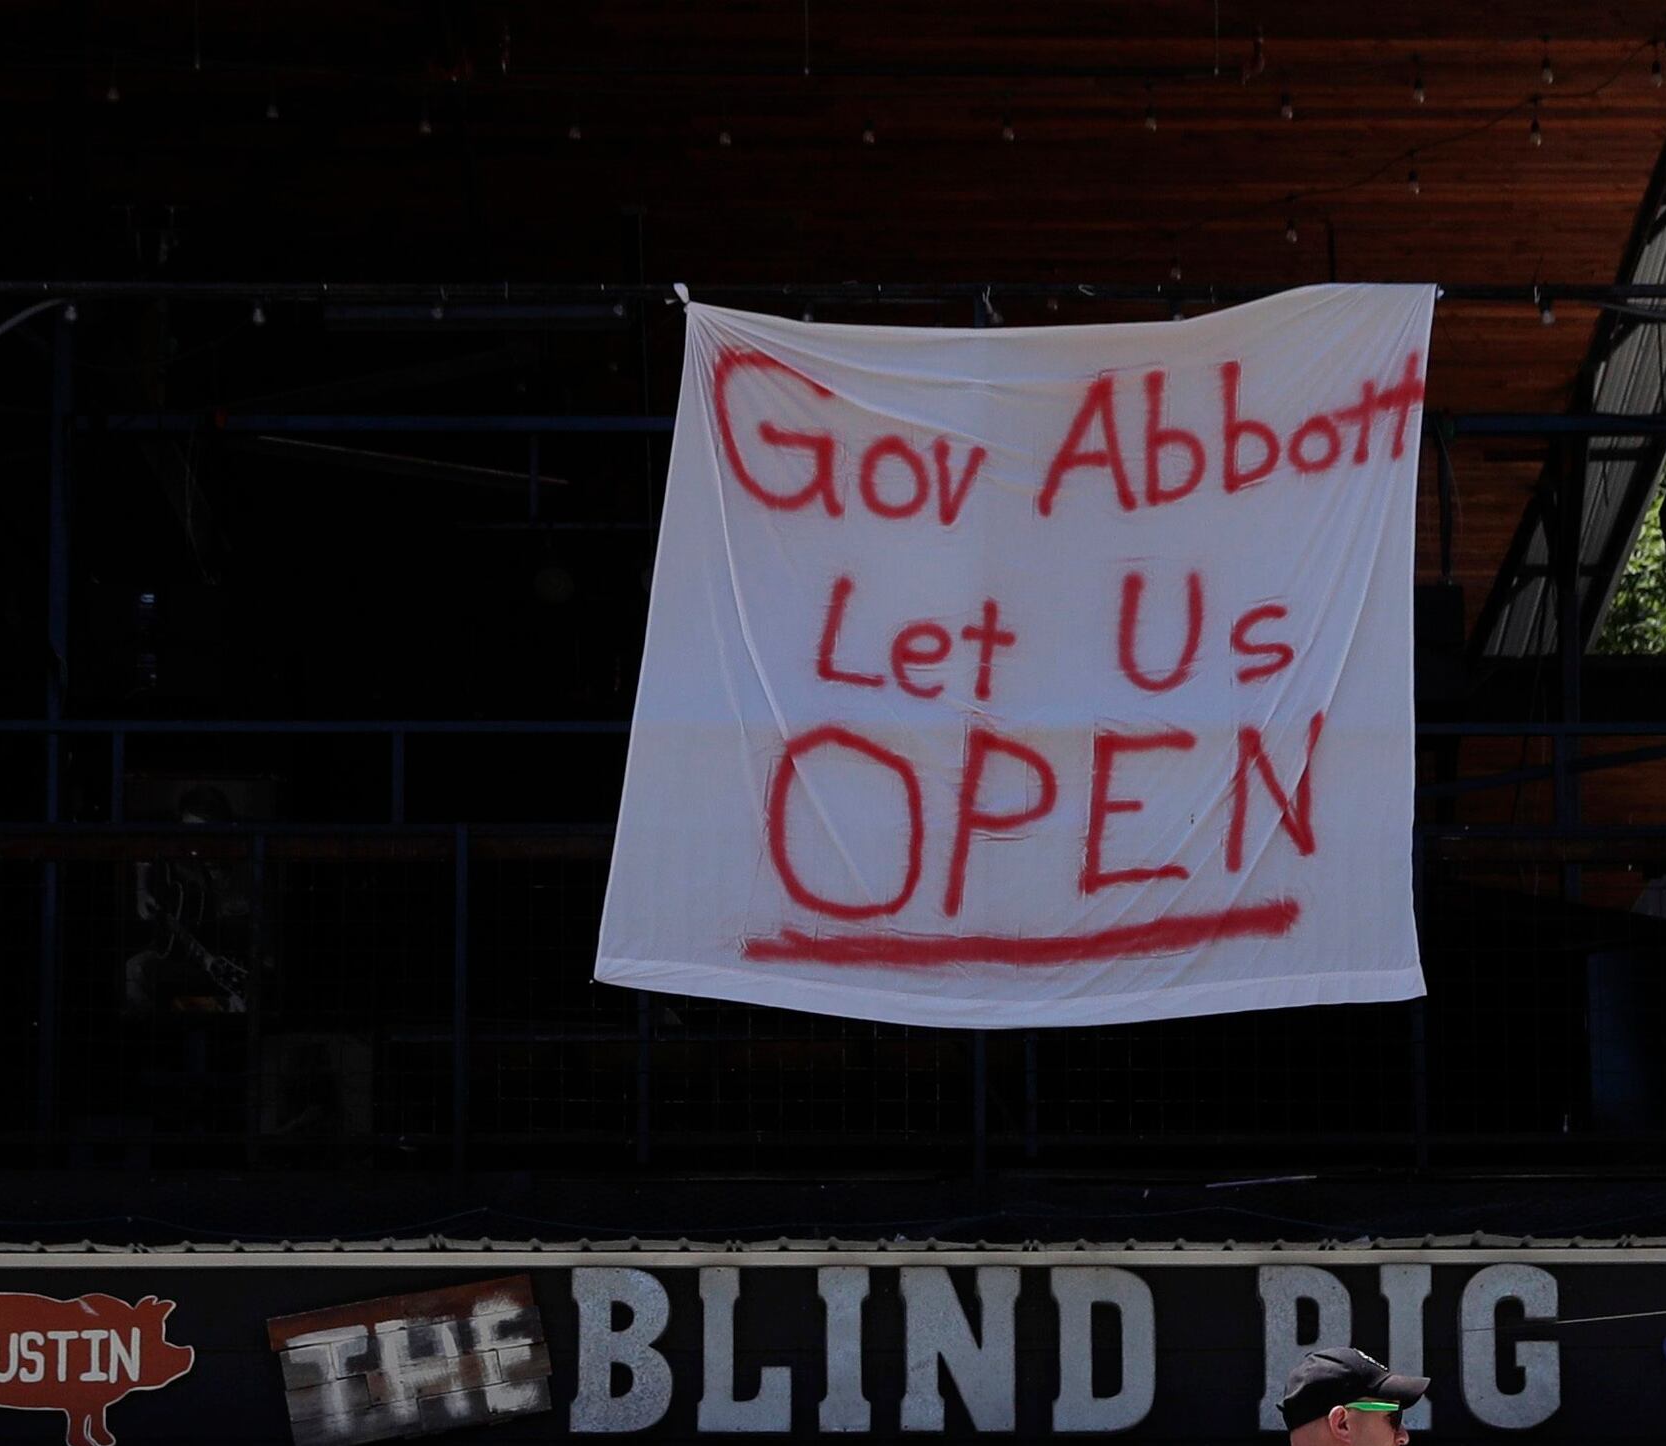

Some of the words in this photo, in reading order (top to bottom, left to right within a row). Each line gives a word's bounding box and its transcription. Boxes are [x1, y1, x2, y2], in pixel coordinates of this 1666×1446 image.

[713, 348, 987, 524] Gov
[1038, 351, 1426, 517] Abbott
[816, 575, 1017, 700] Let
[1117, 571, 1296, 694] Us
[769, 711, 1326, 920] OPEN
[285, 1295, 543, 1437] THE
[570, 1267, 1156, 1433] BLIND
[1258, 1263, 1561, 1431] PIG
